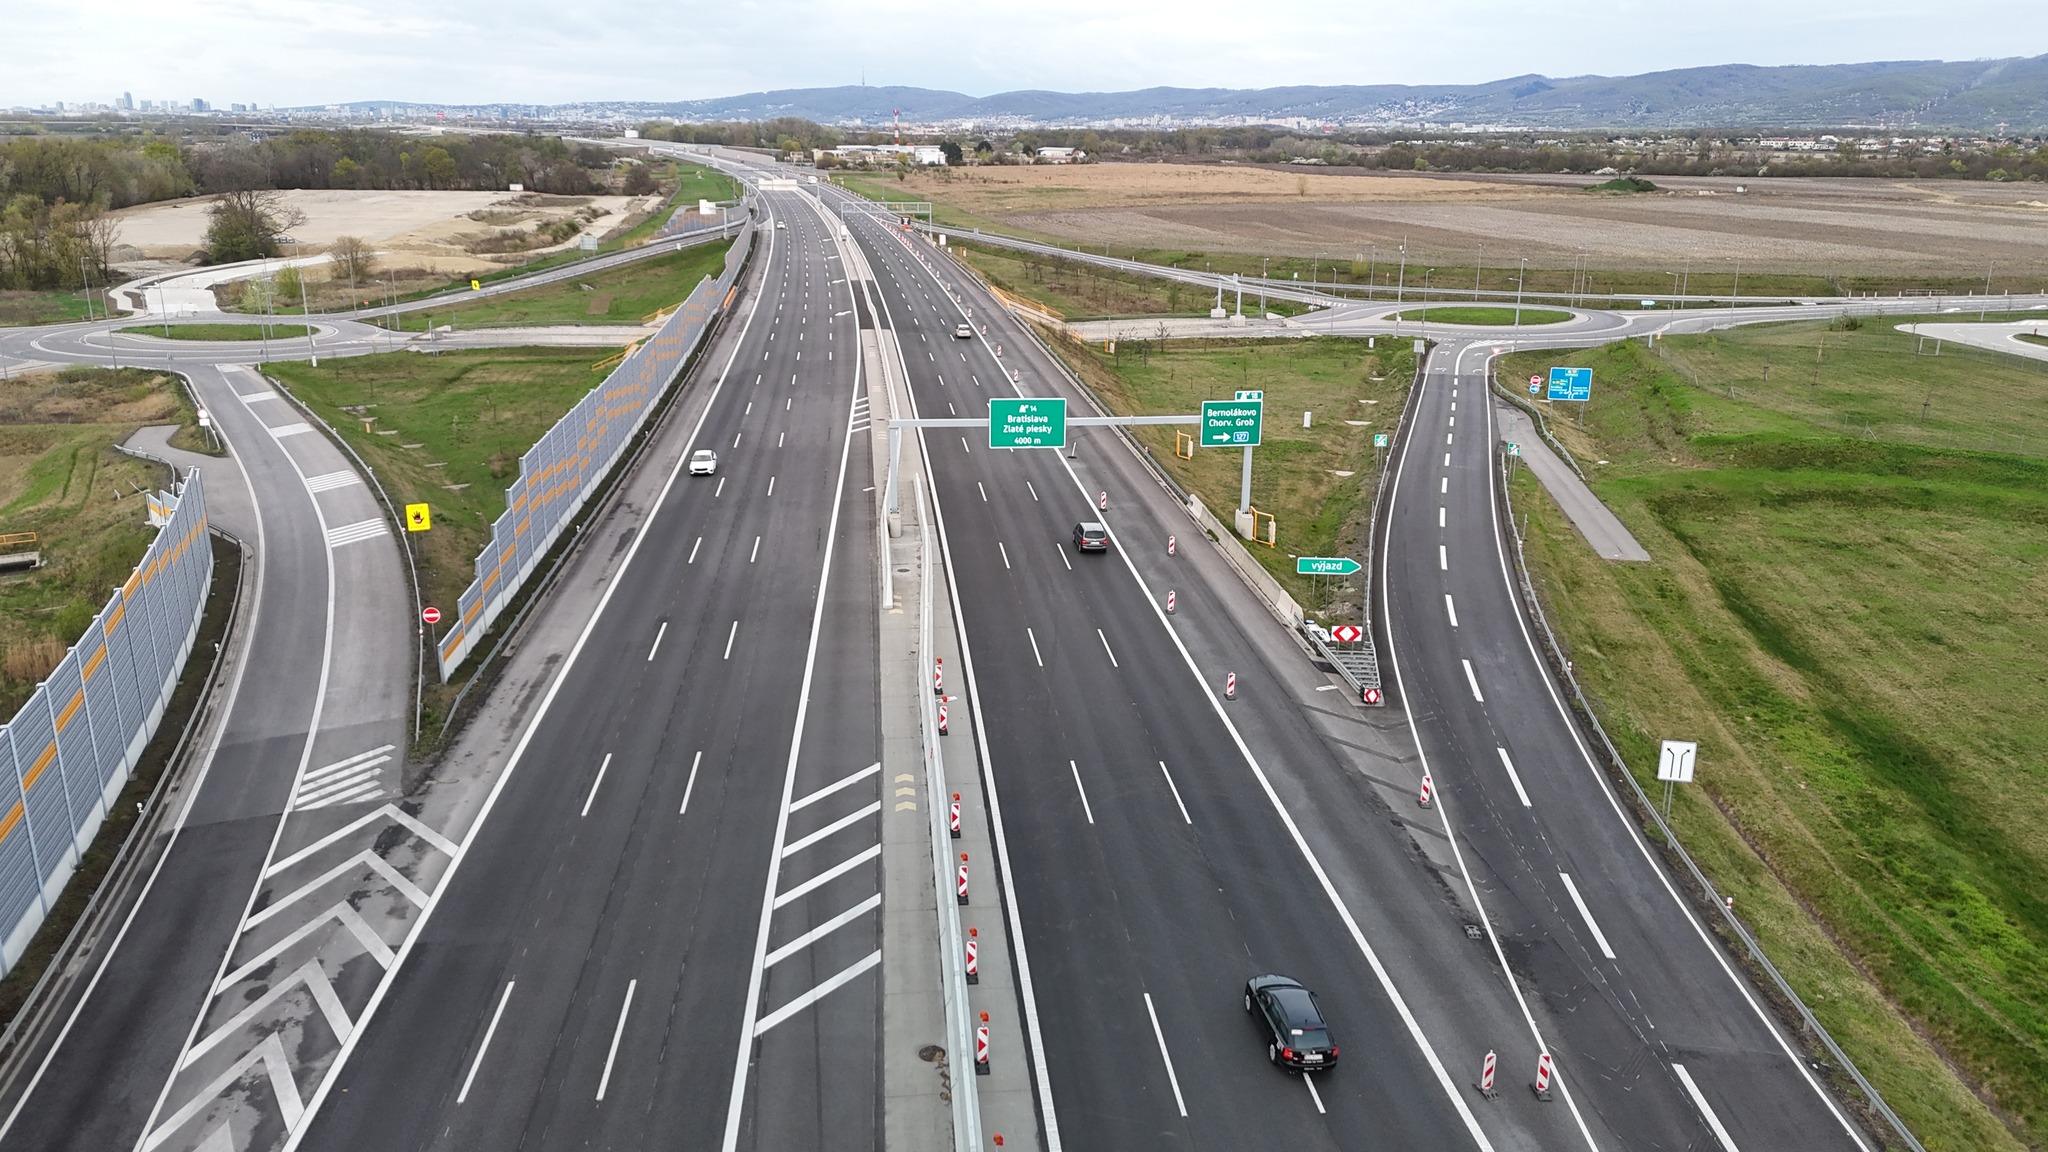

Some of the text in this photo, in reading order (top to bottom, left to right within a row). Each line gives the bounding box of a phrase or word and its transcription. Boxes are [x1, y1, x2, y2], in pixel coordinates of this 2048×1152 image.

[1207, 408, 1257, 417] Bernolákovo
[1007, 414, 1048, 423] Bratislava
[1208, 418, 1255, 427] Chorv. Grob
[1003, 424, 1052, 434] Zlaté piesky
[1014, 437, 1032, 445] 4000
[1311, 560, 1342, 571] výjazd
